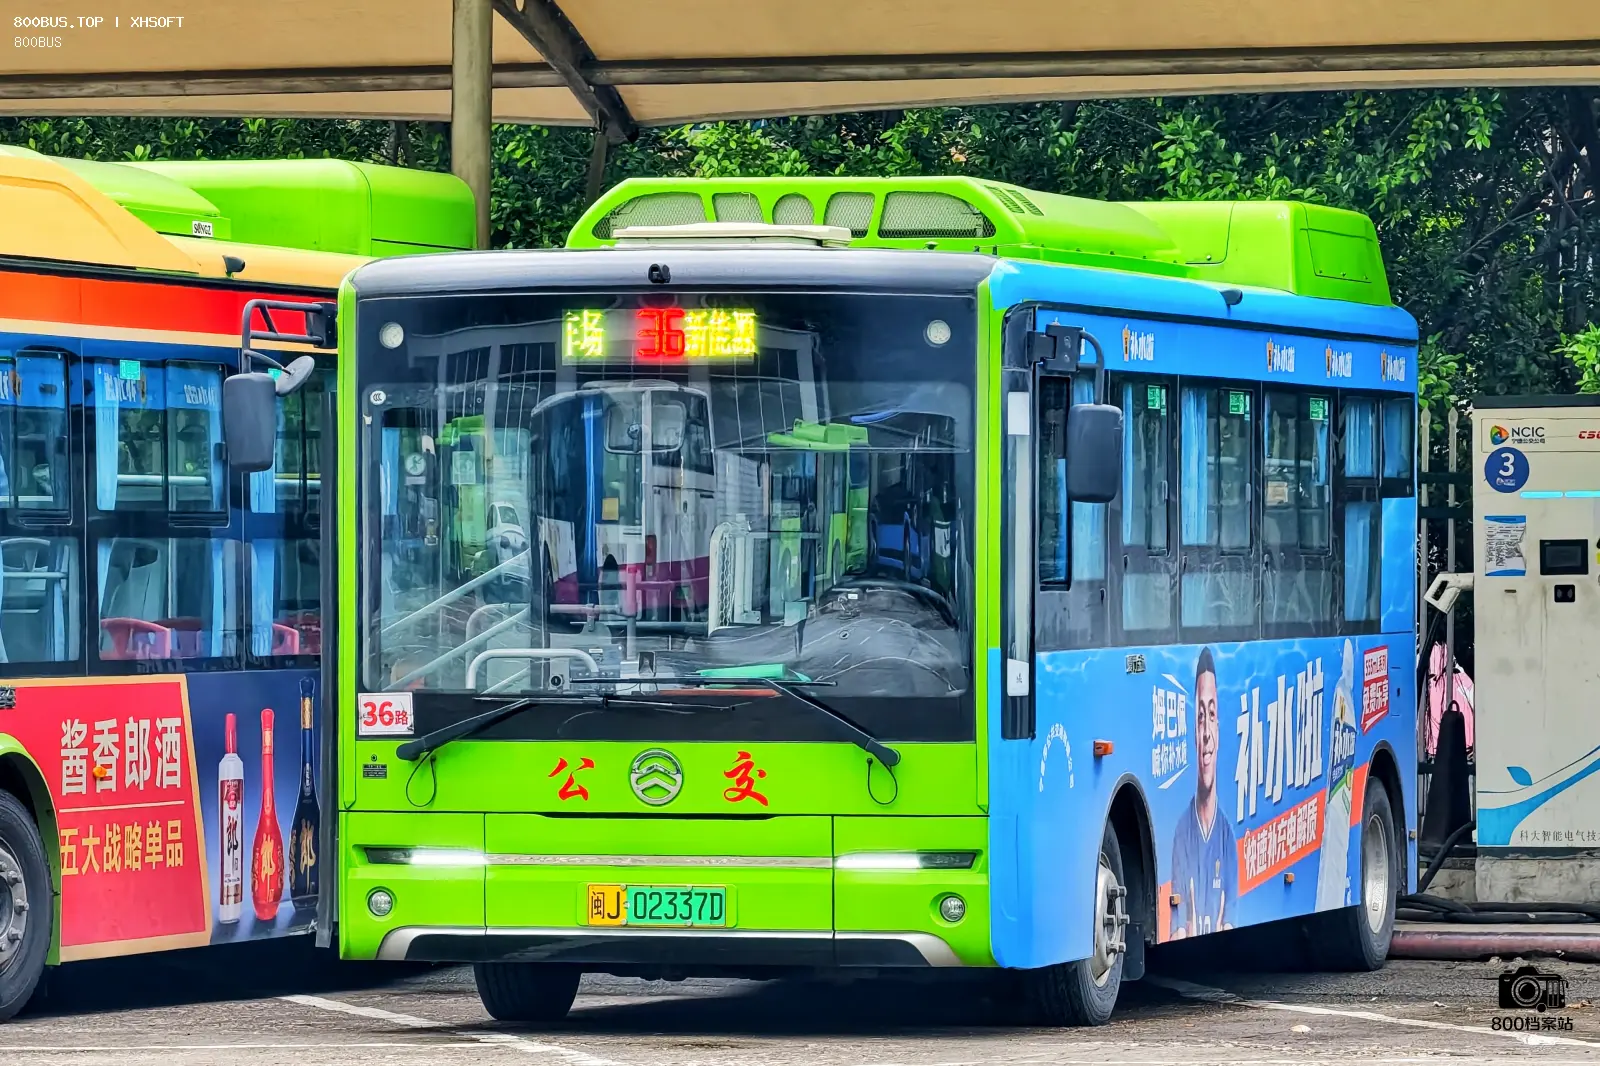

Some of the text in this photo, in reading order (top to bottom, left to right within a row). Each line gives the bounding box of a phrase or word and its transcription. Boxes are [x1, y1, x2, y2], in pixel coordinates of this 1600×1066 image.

[1511, 426, 1545, 437] NCIC
[1498, 452, 1515, 477] 3
[363, 701, 408, 726] 36路
[60, 716, 182, 796] 酱香郎酒
[1235, 657, 1324, 823] 补水啦
[548, 751, 769, 806] 公 交
[60, 820, 184, 876] 五大战略单品
[1245, 797, 1319, 882] 快速补充电解质
[1520, 829, 1600, 844] 科大智能电气技
[591, 891, 723, 921] 闽J 02337D
